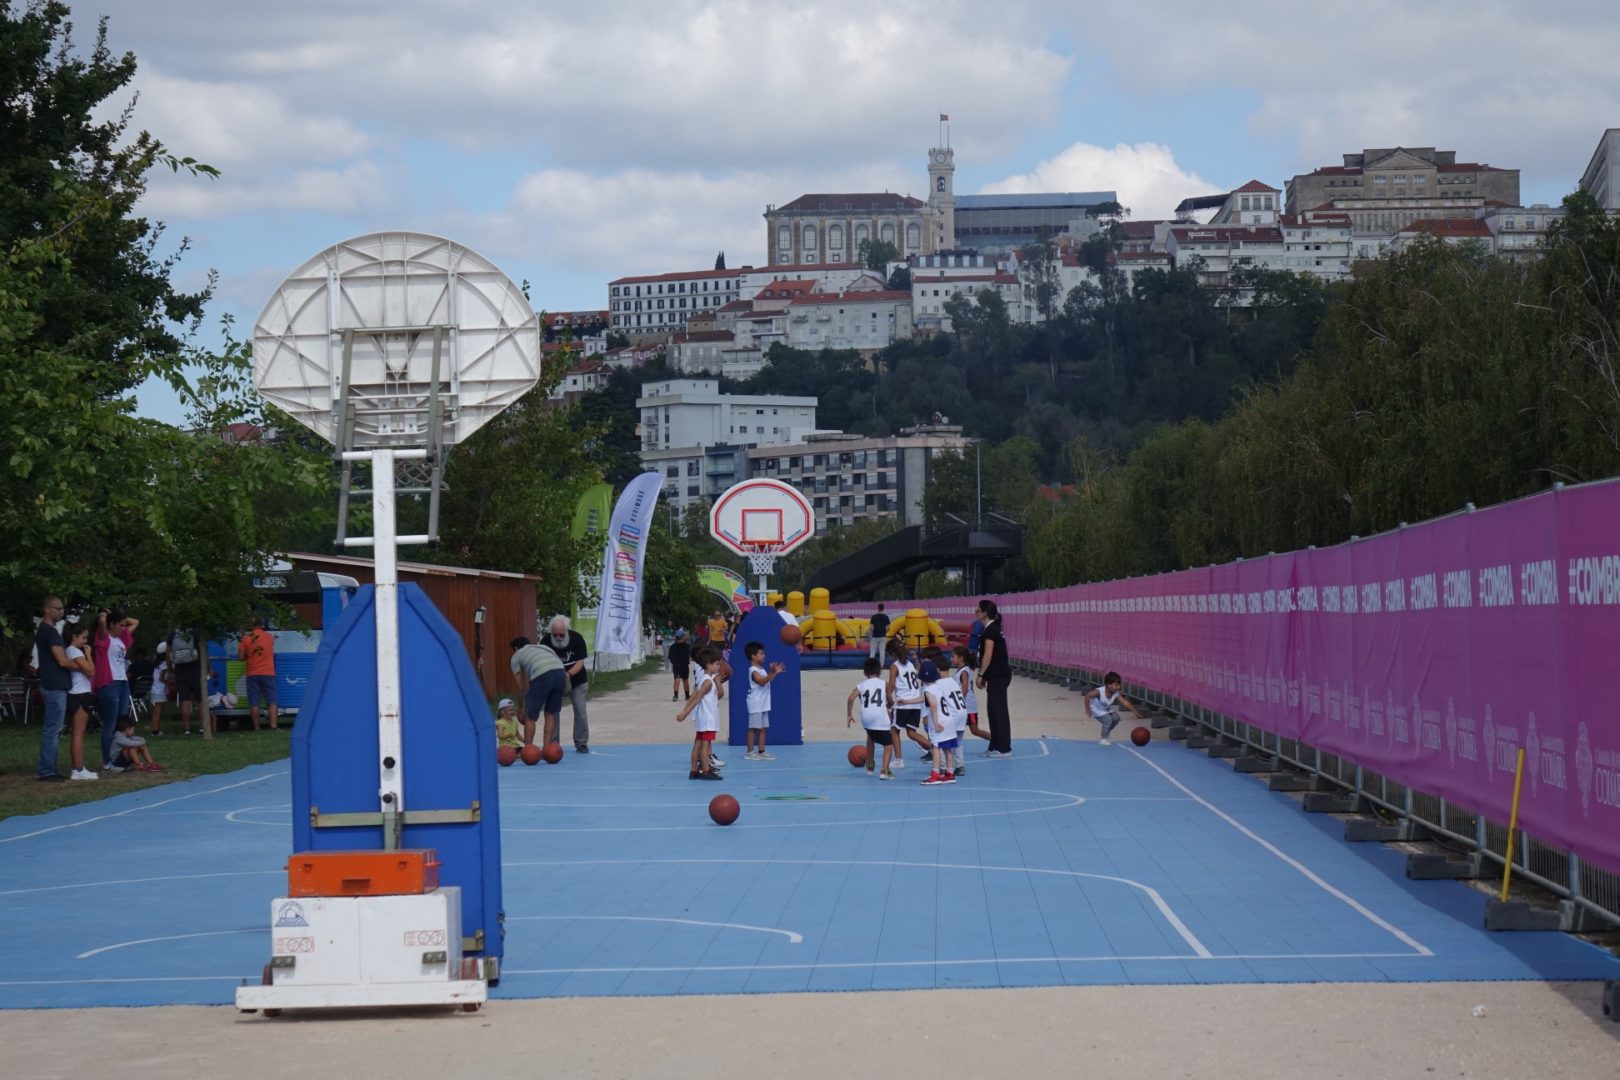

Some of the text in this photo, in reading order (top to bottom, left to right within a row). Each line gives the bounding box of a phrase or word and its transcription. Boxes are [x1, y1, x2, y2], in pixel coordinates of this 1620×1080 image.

[1521, 559, 1559, 606] #COIMBRA
[903, 671, 919, 690] 18
[862, 688, 884, 708] 14
[949, 690, 967, 710] 15
